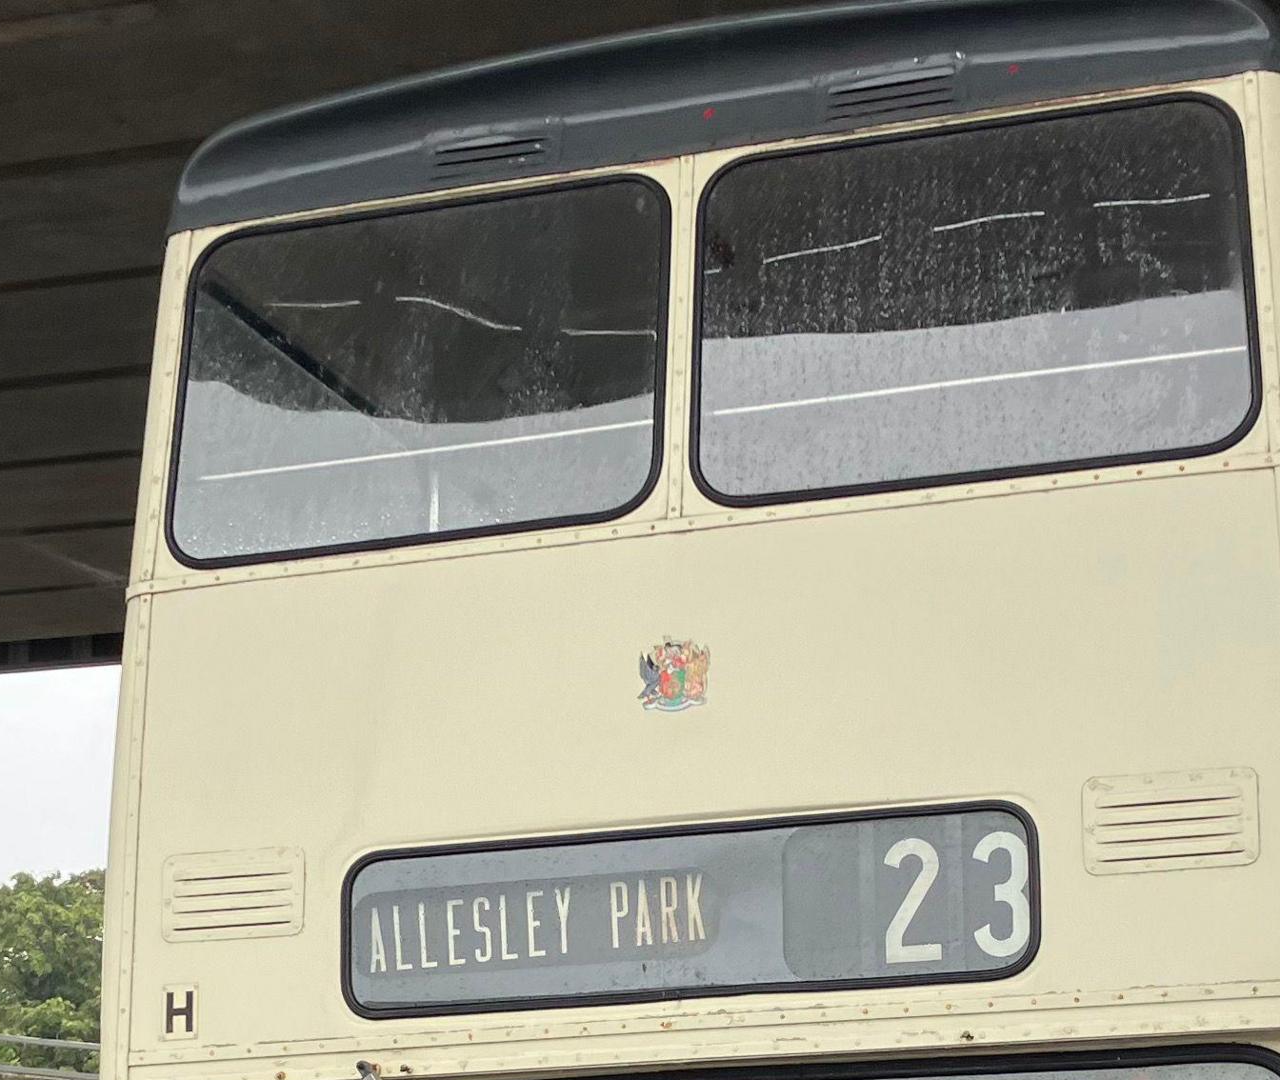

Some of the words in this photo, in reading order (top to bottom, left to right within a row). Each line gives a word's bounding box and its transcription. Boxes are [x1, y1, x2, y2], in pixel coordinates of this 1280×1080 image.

[369, 887, 571, 973] ALLESLEY
[609, 873, 706, 949] PARK
[883, 831, 1031, 964] 23
[165, 990, 194, 1034] H
